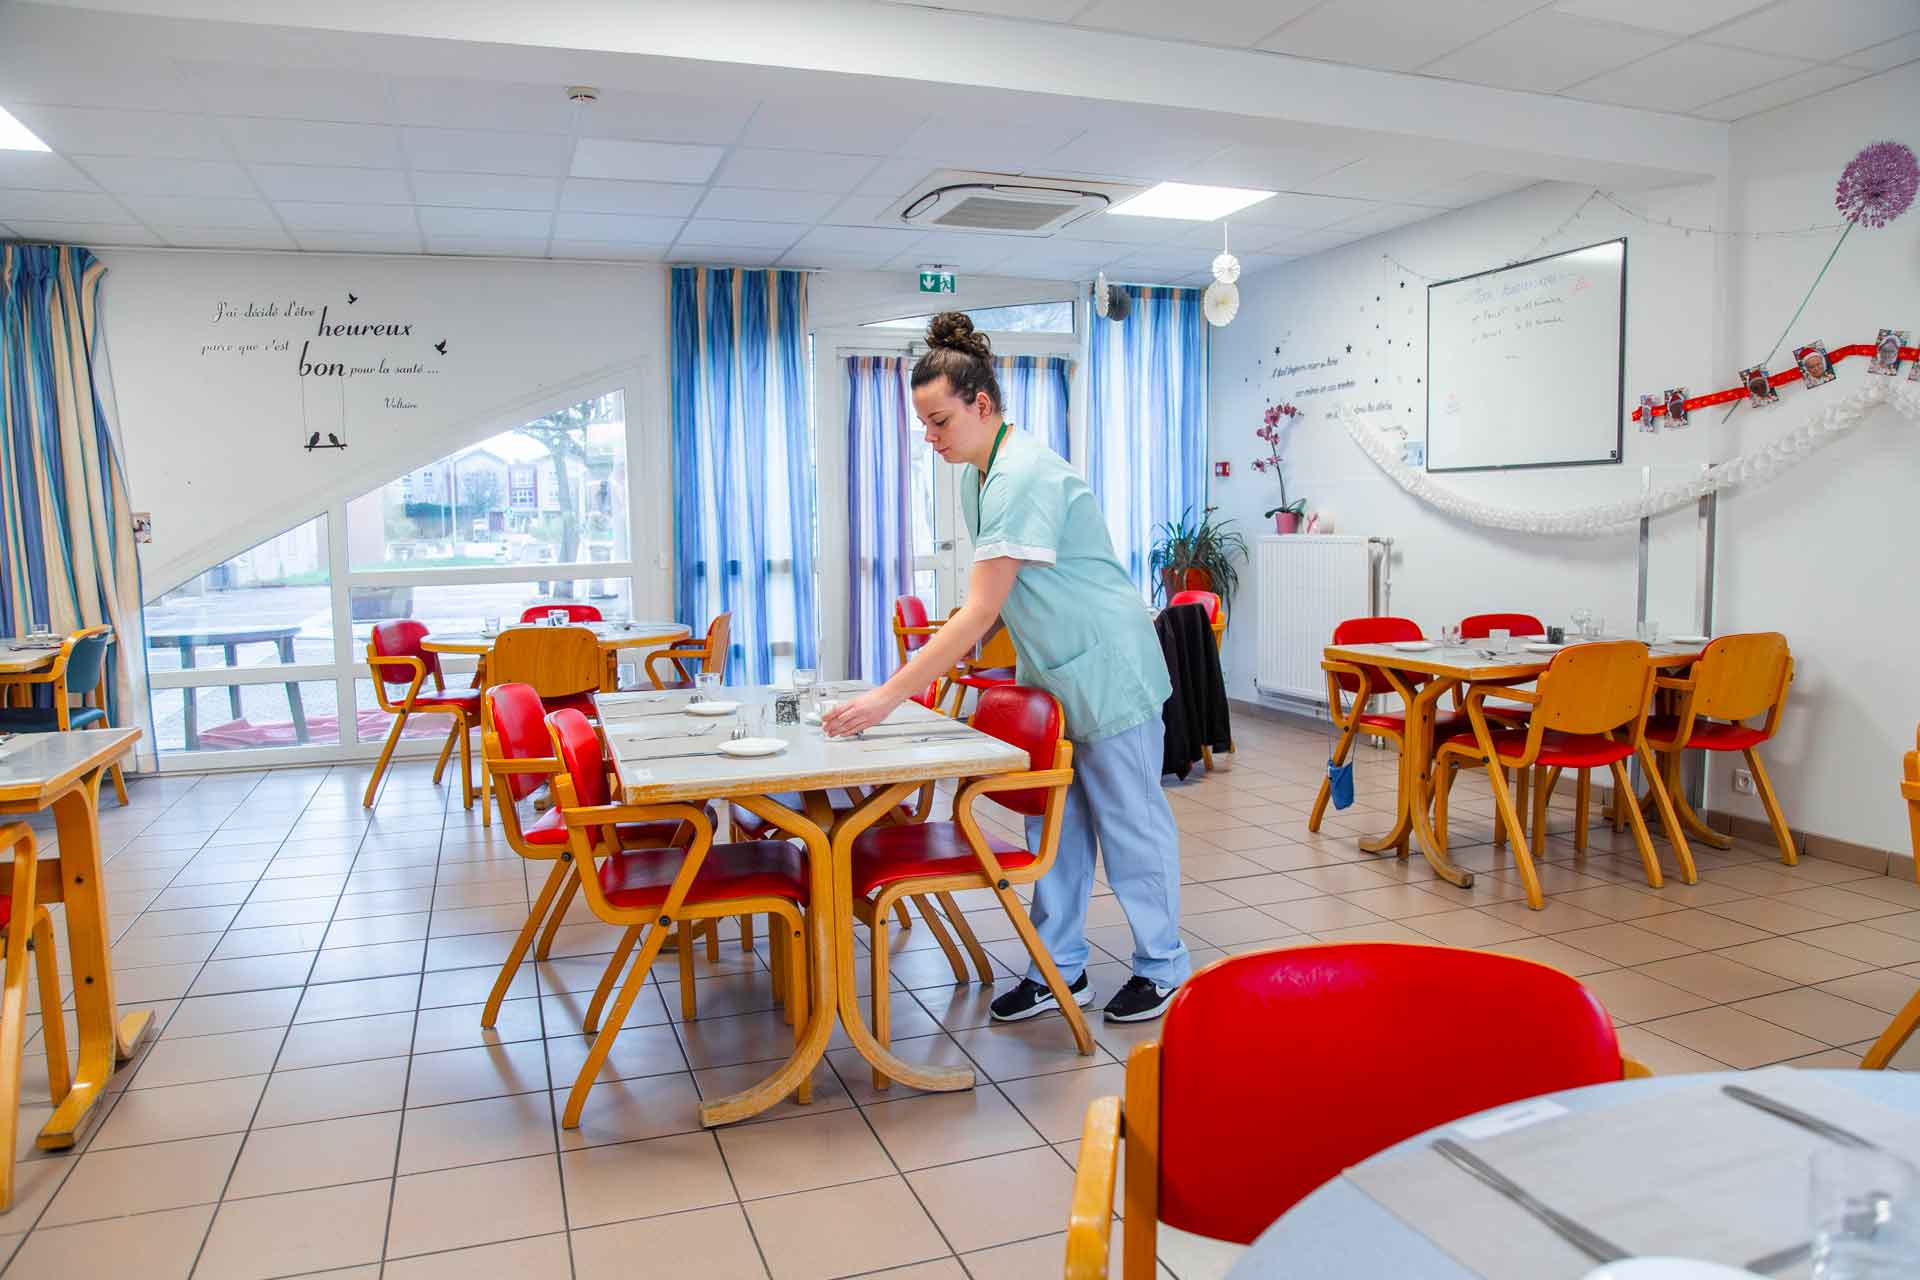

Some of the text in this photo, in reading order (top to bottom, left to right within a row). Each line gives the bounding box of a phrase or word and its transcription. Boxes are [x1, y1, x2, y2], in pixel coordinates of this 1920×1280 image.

[212, 301, 413, 337] J'ai décidé d'être heureux
[201, 343, 231, 355] parce
[238, 343, 257, 354] que
[264, 339, 289, 351] c'est
[299, 341, 345, 377] bon
[349, 366, 376, 377] pour
[379, 358, 390, 374] la
[383, 397, 418, 409] Voltaire
